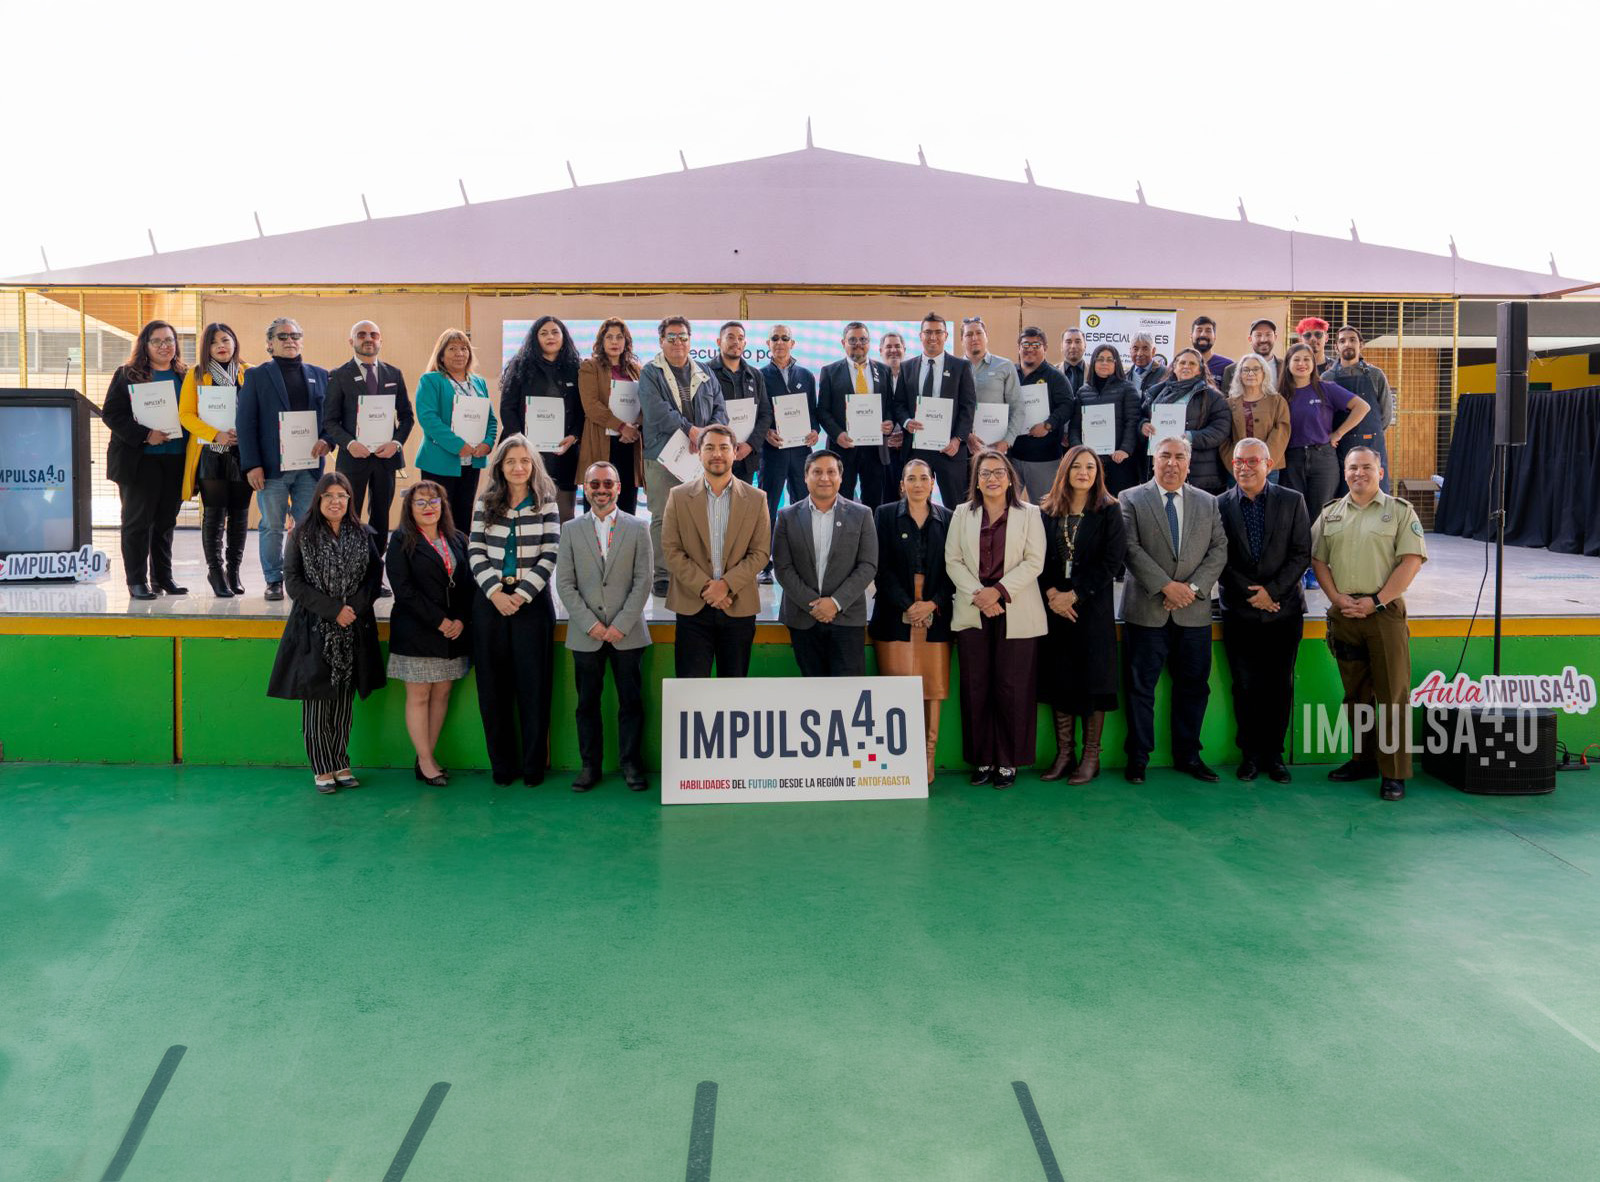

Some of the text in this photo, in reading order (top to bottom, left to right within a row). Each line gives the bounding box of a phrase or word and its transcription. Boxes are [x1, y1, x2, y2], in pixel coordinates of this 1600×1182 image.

[1414, 674, 1484, 704] Aula
[680, 775, 910, 790] HABILIDADES DEL FUTURO DESDE LA REGIÓN DE ANTOFAGASTA
